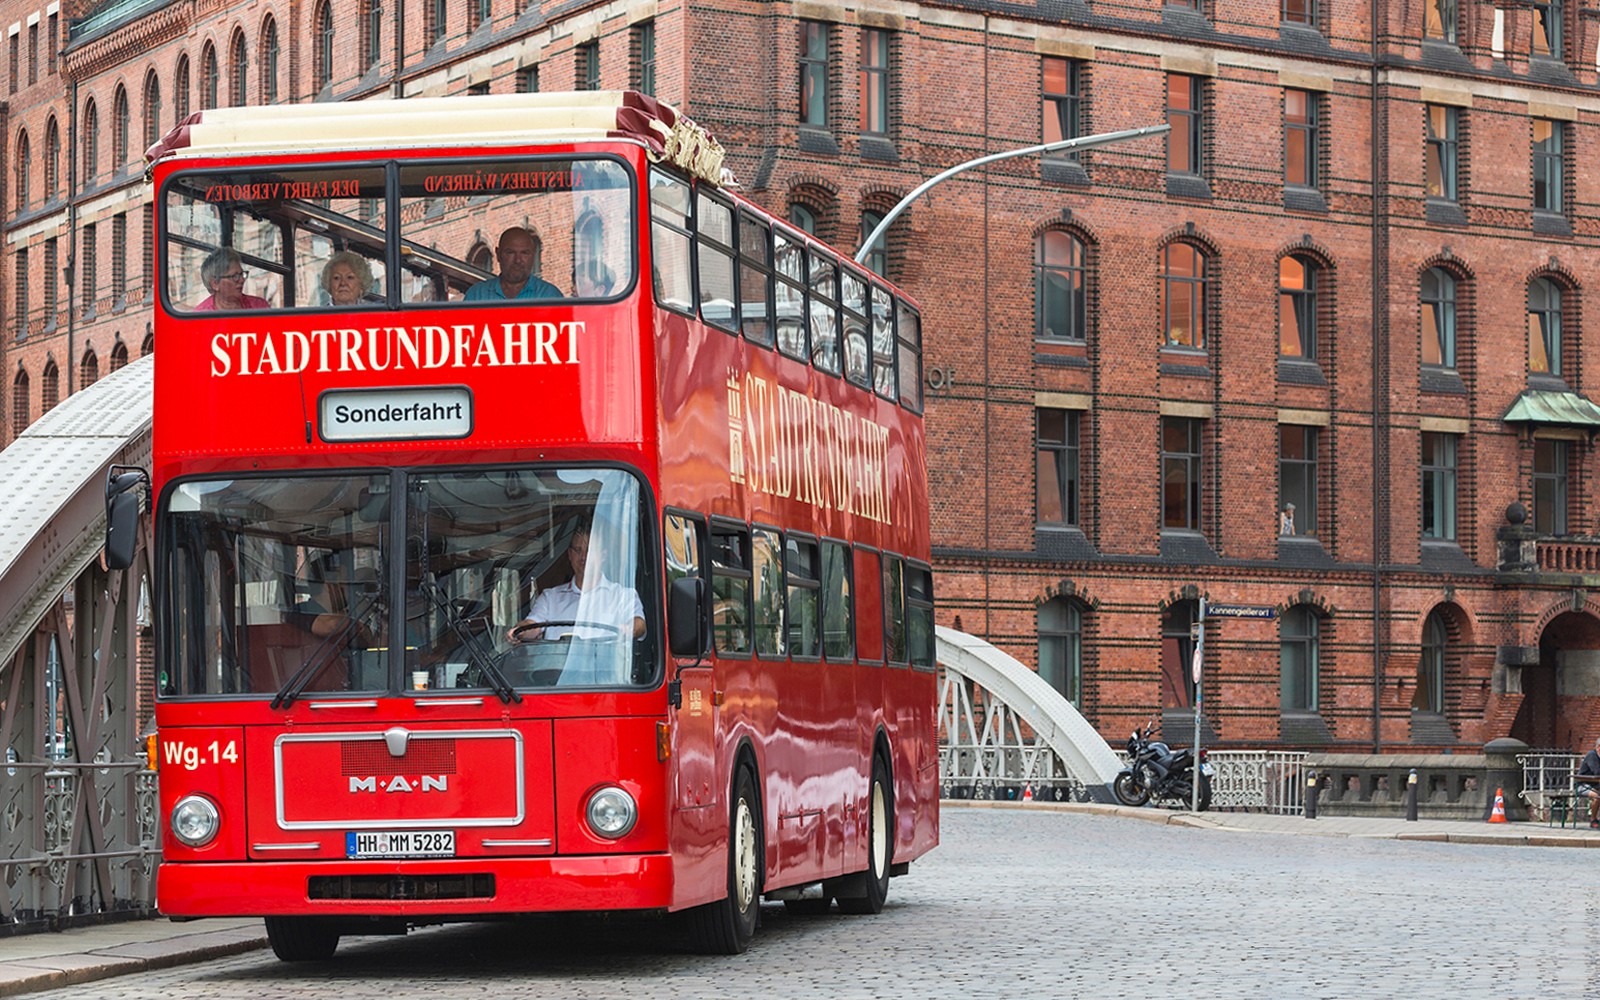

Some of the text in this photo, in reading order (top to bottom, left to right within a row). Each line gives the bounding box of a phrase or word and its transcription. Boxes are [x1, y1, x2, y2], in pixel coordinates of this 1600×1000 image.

[210, 321, 585, 377] STADTRUNDFAHRT
[334, 402, 463, 424] Sonderfahrt
[745, 371, 892, 526] STADTRUNDFAHRT
[163, 740, 239, 771] Wg.14
[357, 834, 378, 853] HH
[389, 834, 410, 852] MM
[413, 833, 453, 852] 5282
